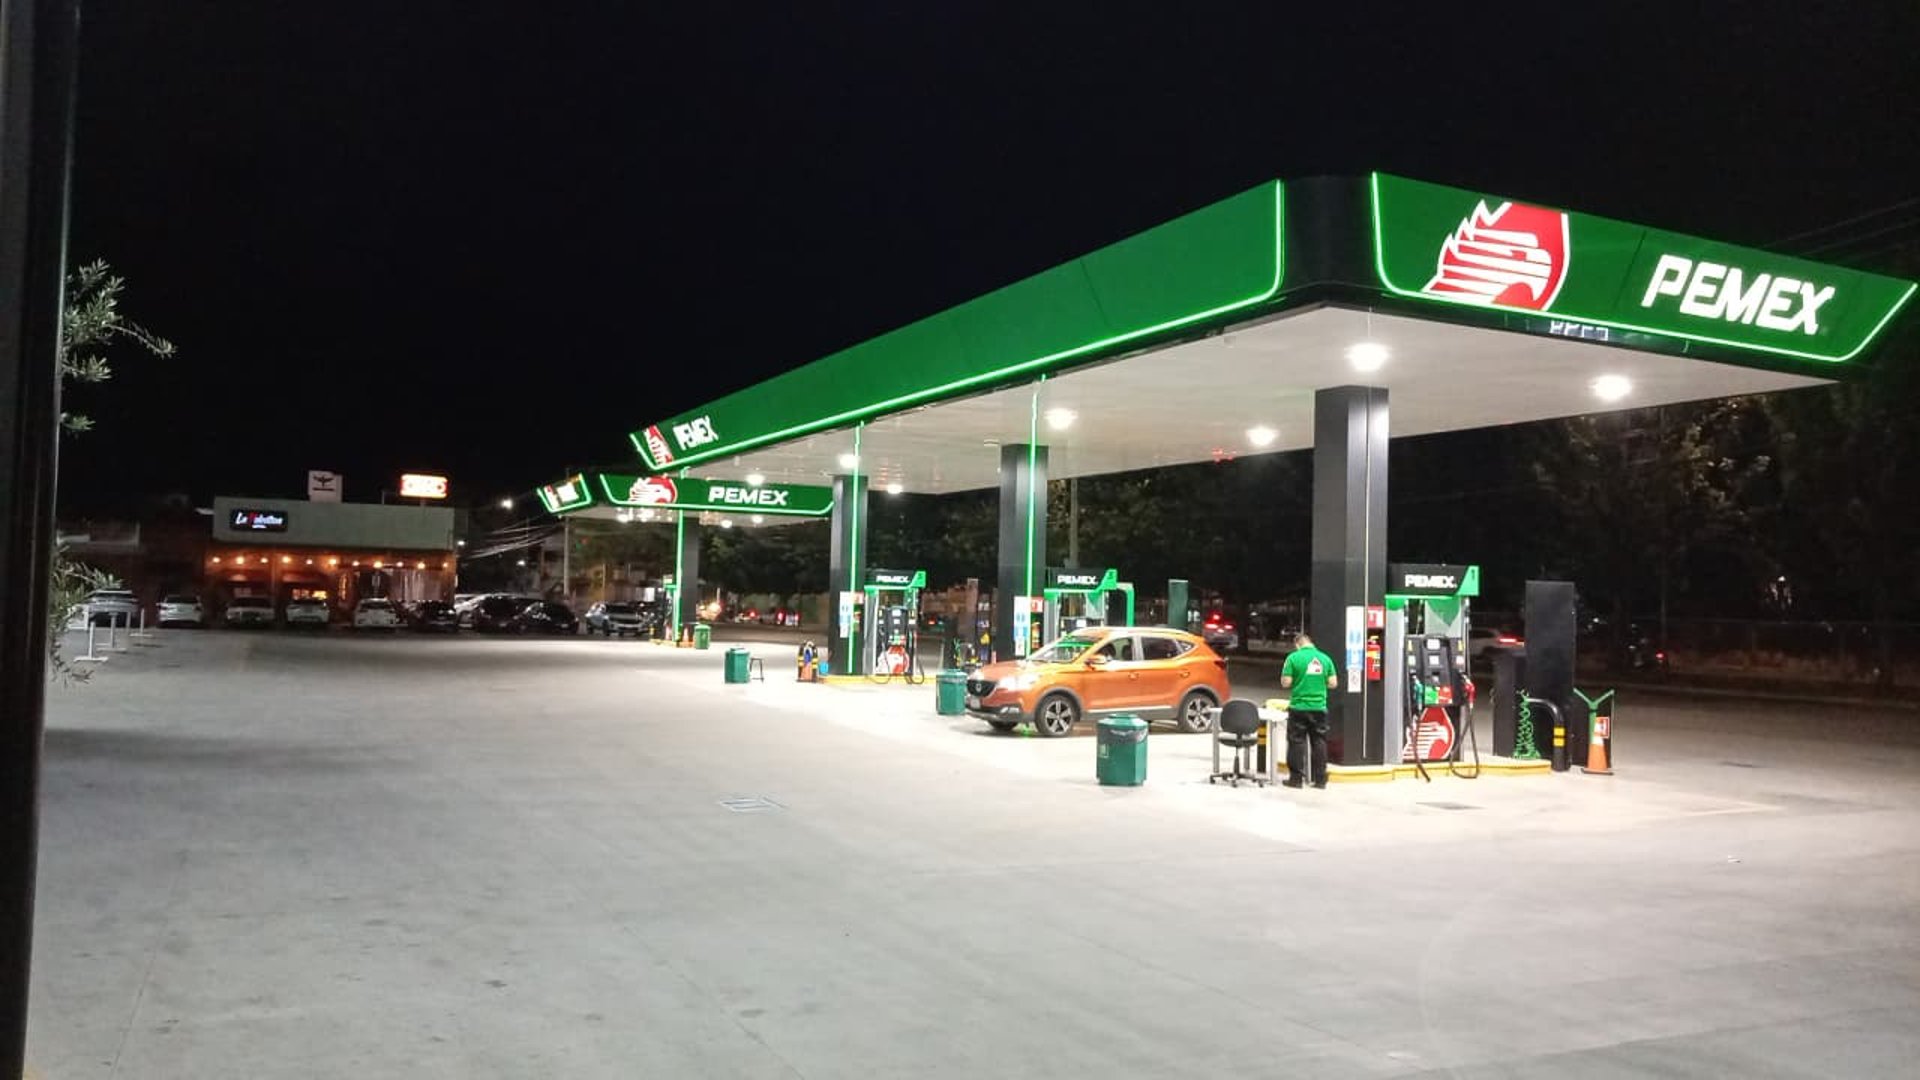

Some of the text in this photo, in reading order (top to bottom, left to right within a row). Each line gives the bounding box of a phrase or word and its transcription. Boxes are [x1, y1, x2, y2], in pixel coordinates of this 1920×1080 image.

[1641, 254, 1836, 335] PEMEX
[672, 415, 719, 451] PEMEX
[708, 486, 789, 506] PEMEX
[1057, 575, 1098, 585] PEMEX
[1404, 574, 1455, 589] PEMEX
